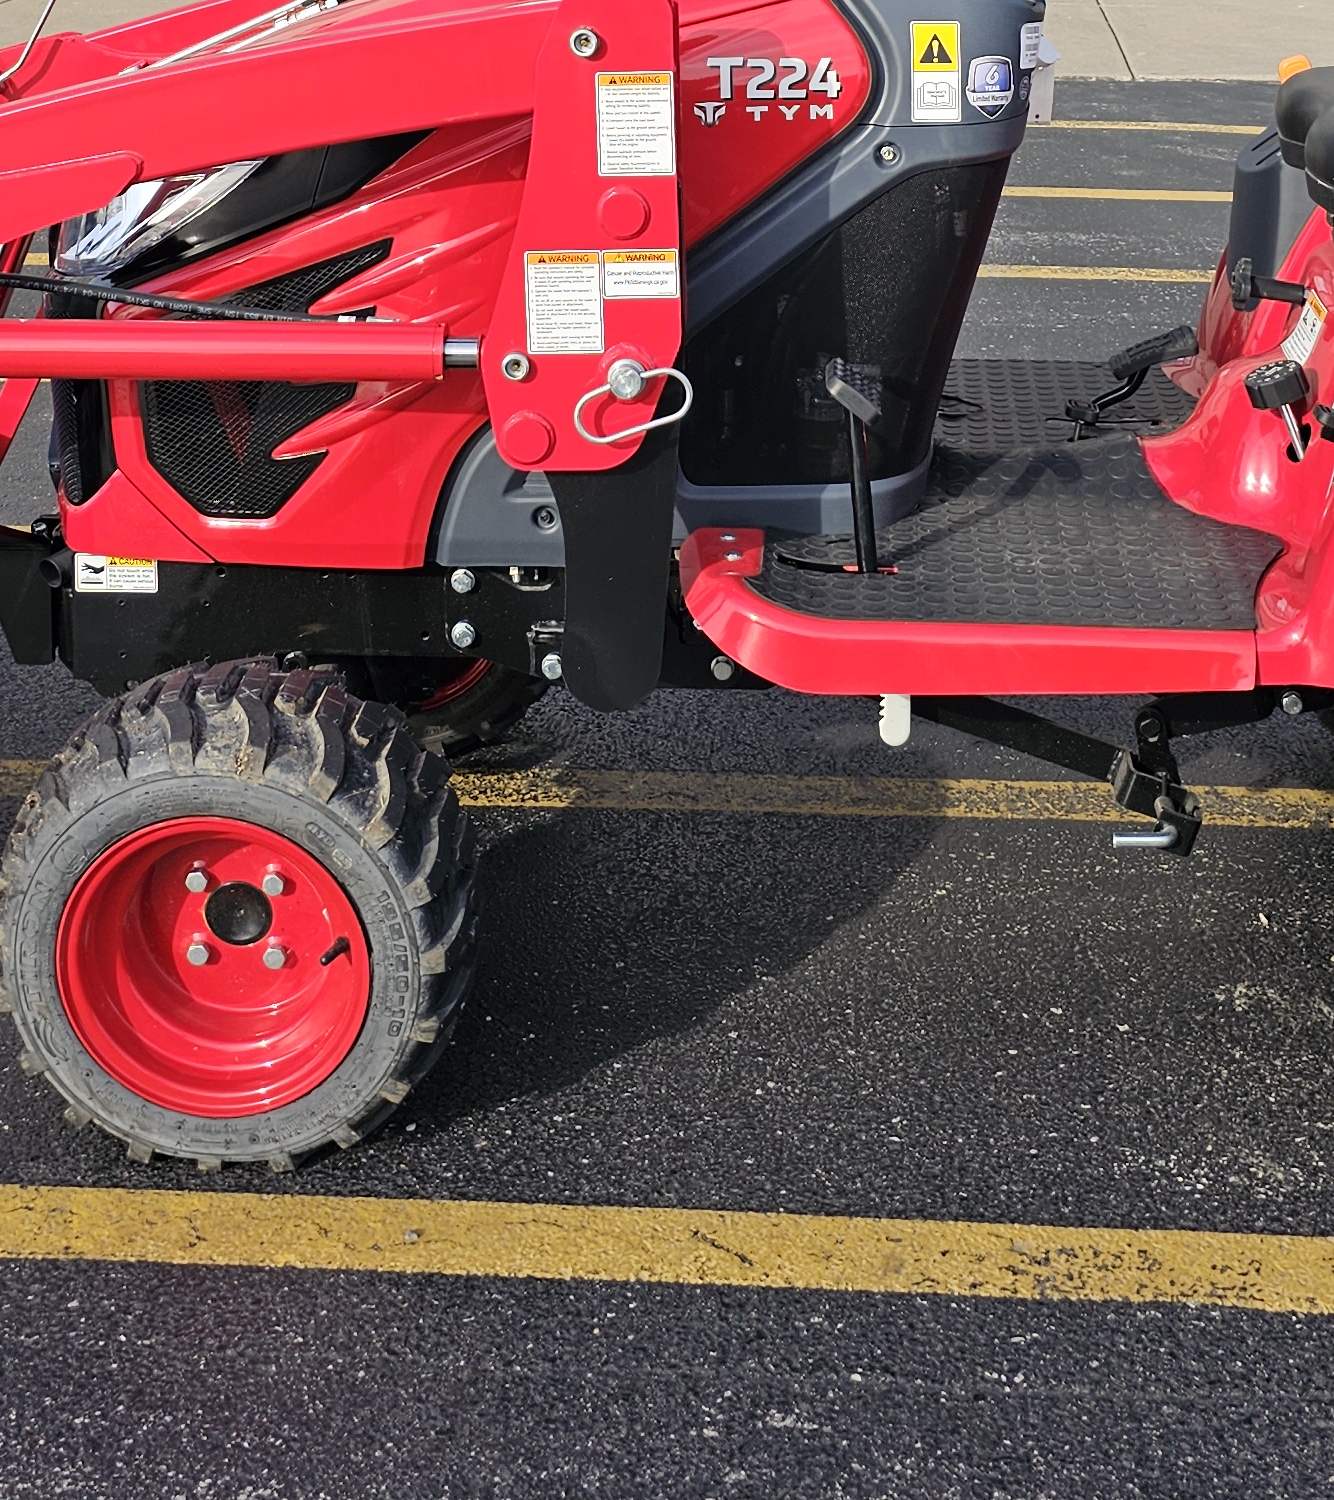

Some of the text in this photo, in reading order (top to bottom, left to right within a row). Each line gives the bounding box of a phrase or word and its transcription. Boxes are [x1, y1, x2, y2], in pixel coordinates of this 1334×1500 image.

[618, 75, 661, 84] WARNING
[706, 56, 843, 101] T224
[985, 64, 1000, 85] 6
[745, 103, 834, 122] TYM
[548, 254, 589, 263] WARNING
[625, 253, 666, 262] WARNING
[118, 557, 153, 566] CAUTION
[18, 879, 50, 1011] TIRON
[376, 889, 409, 1038] 195/50-10
